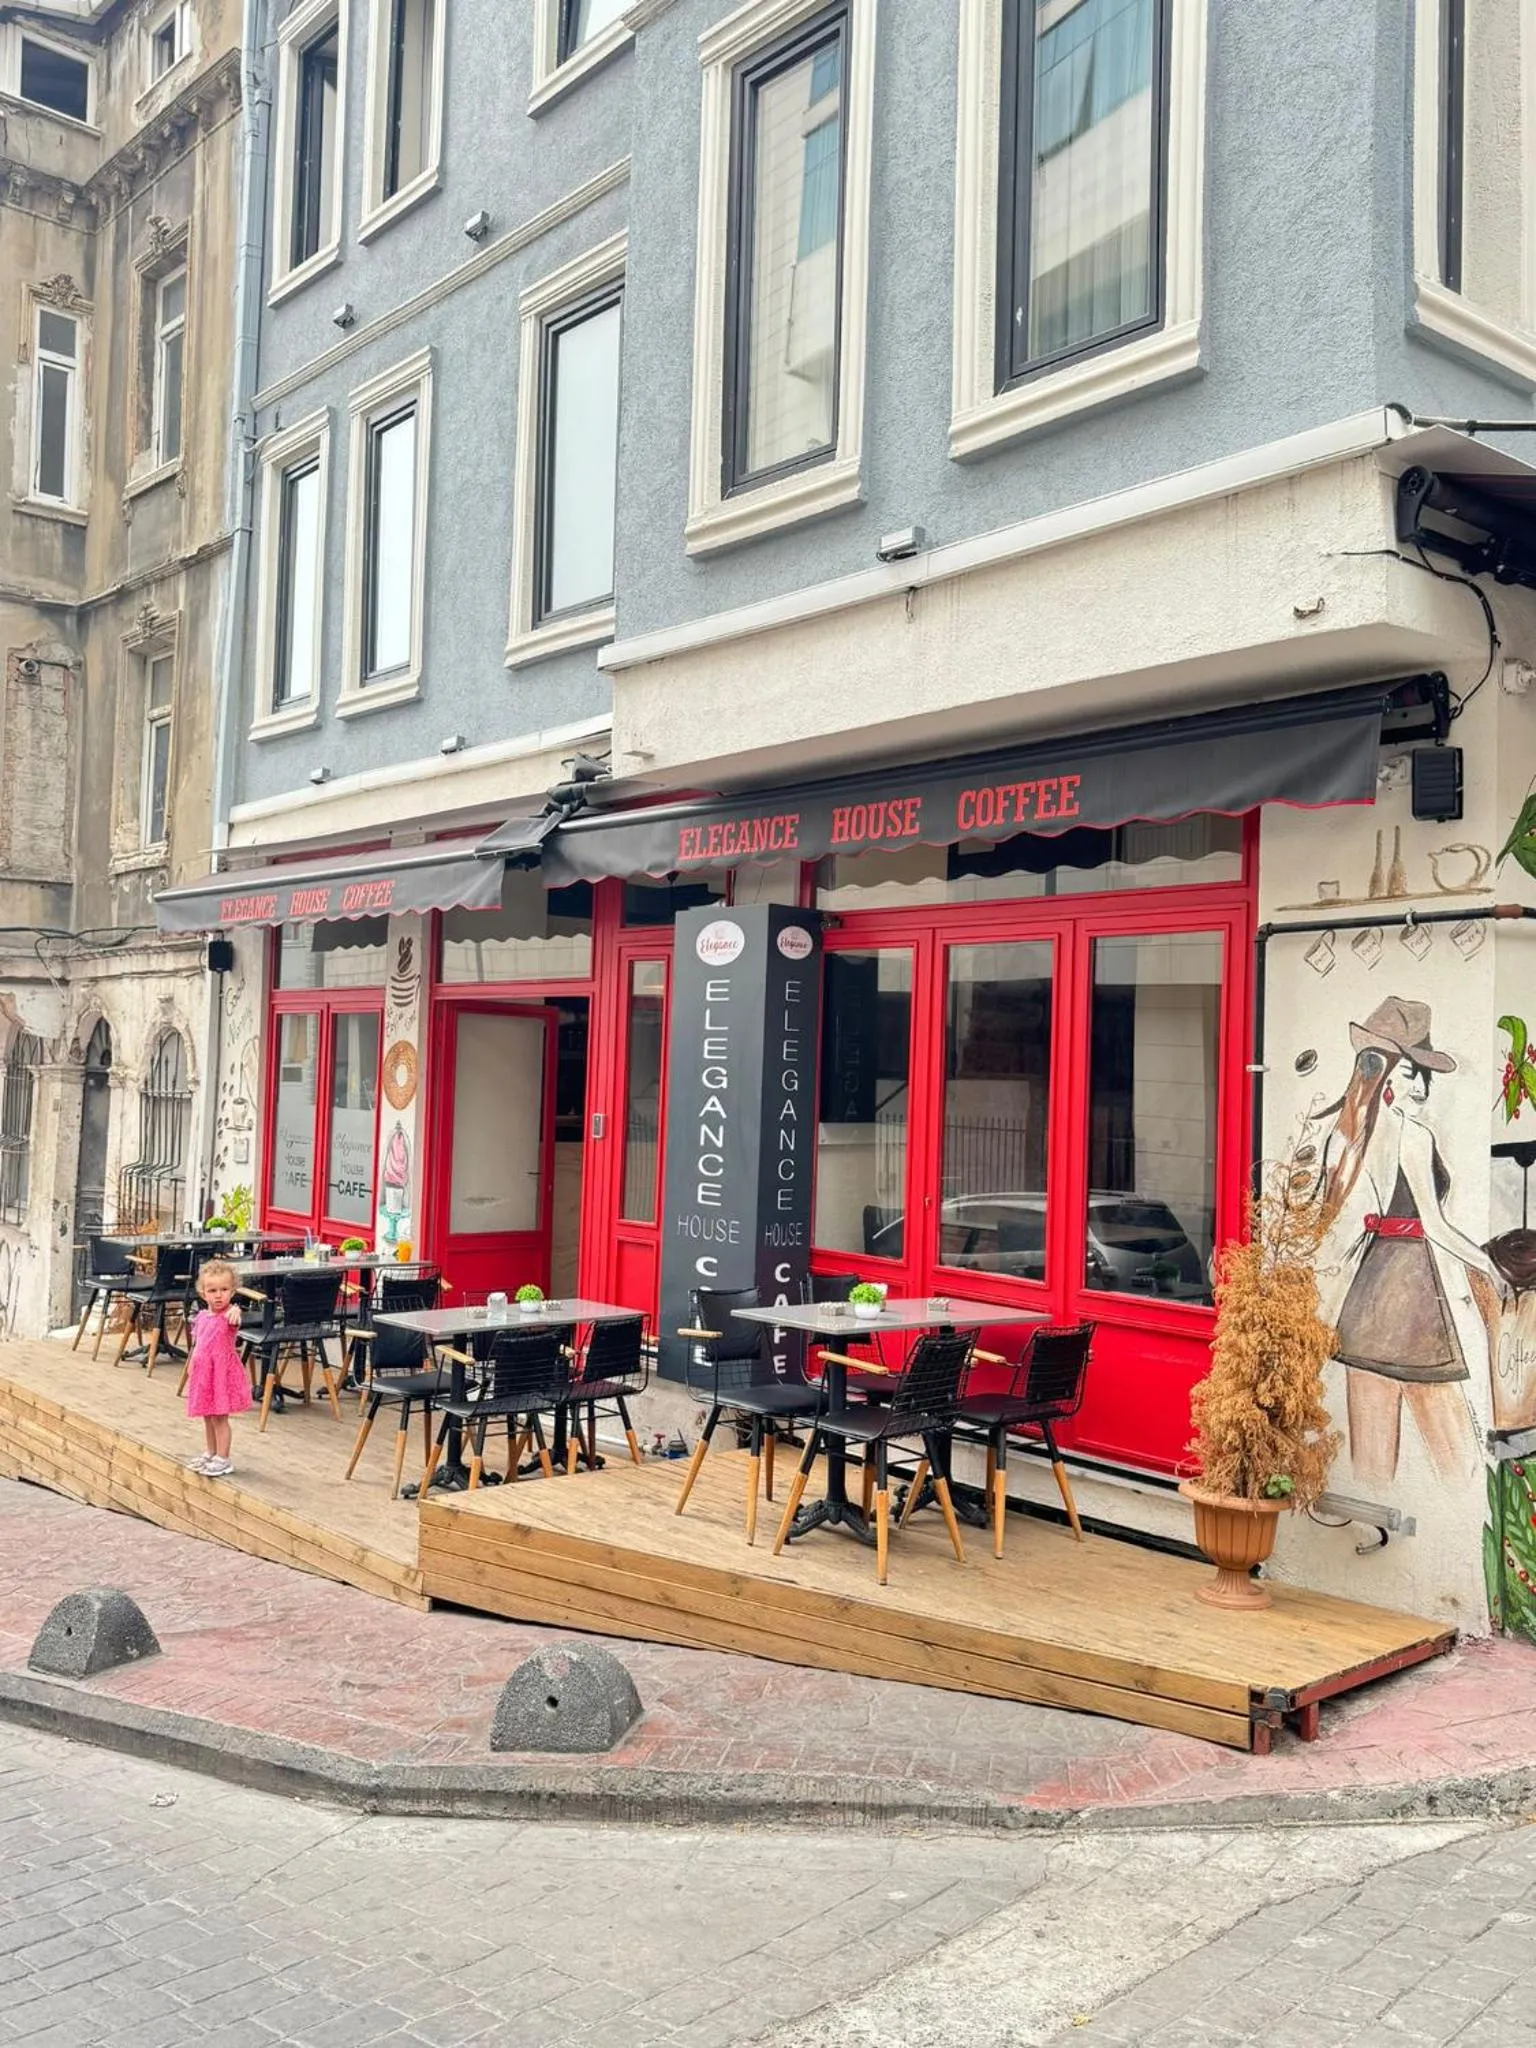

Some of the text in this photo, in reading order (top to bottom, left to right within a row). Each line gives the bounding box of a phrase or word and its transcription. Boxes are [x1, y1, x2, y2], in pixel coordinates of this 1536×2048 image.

[678, 774, 1082, 860] ELEGANCE HOUSE COFFEE
[220, 879, 396, 922] ELEGANCE HOUSE COFFEE
[697, 978, 732, 1206] ELEGANCE
[776, 980, 802, 1211] ELEGANCE
[337, 1179, 366, 1199] CAFE
[676, 1214, 741, 1245] HOUSE
[765, 1222, 803, 1247] HOUSE
[693, 1256, 719, 1367] CE
